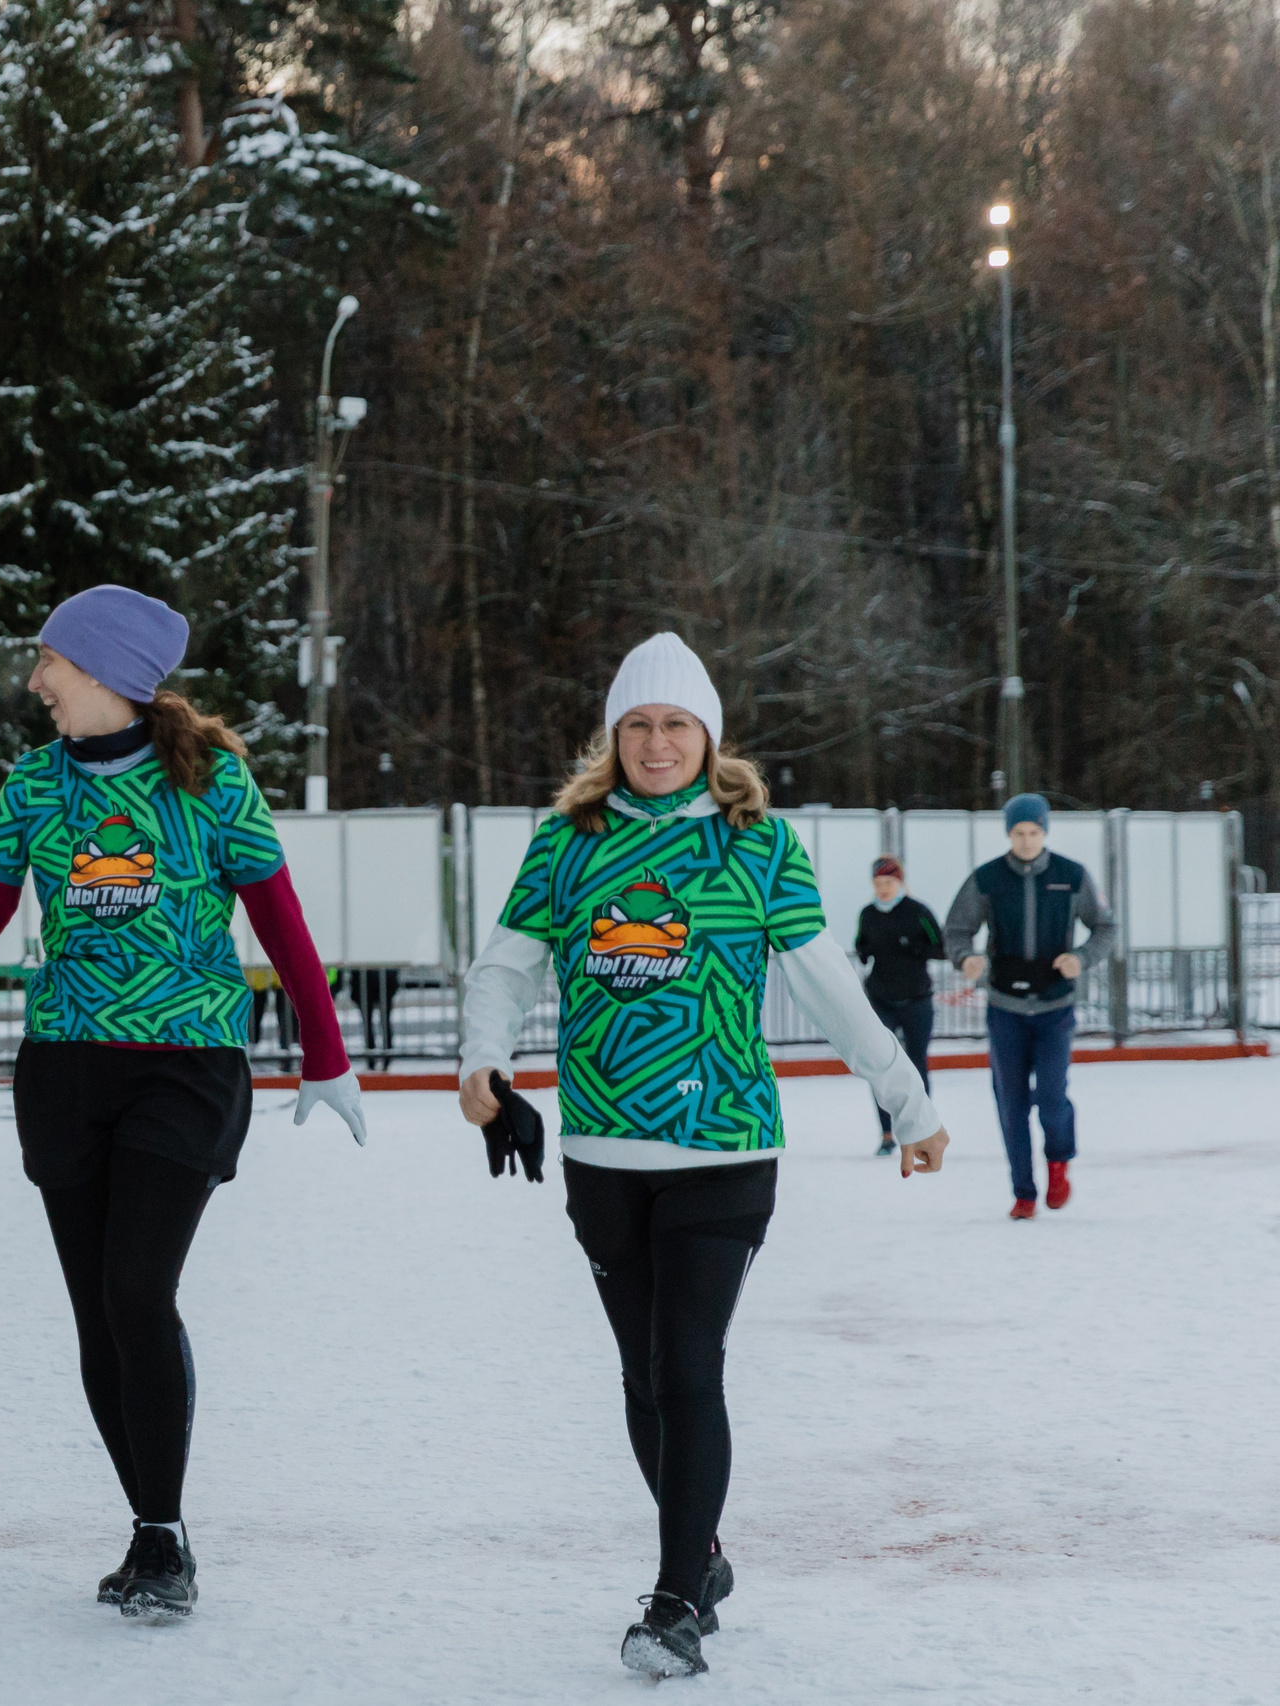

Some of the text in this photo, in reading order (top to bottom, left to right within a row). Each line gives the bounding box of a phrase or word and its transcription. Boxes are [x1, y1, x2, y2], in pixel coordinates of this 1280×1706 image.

[65, 884, 160, 907] МЫТИЩИ
[95, 905, 129, 917] БЕГУТ
[586, 955, 688, 980] МЫТИЩИ
[611, 975, 649, 988] БЕГУТ
